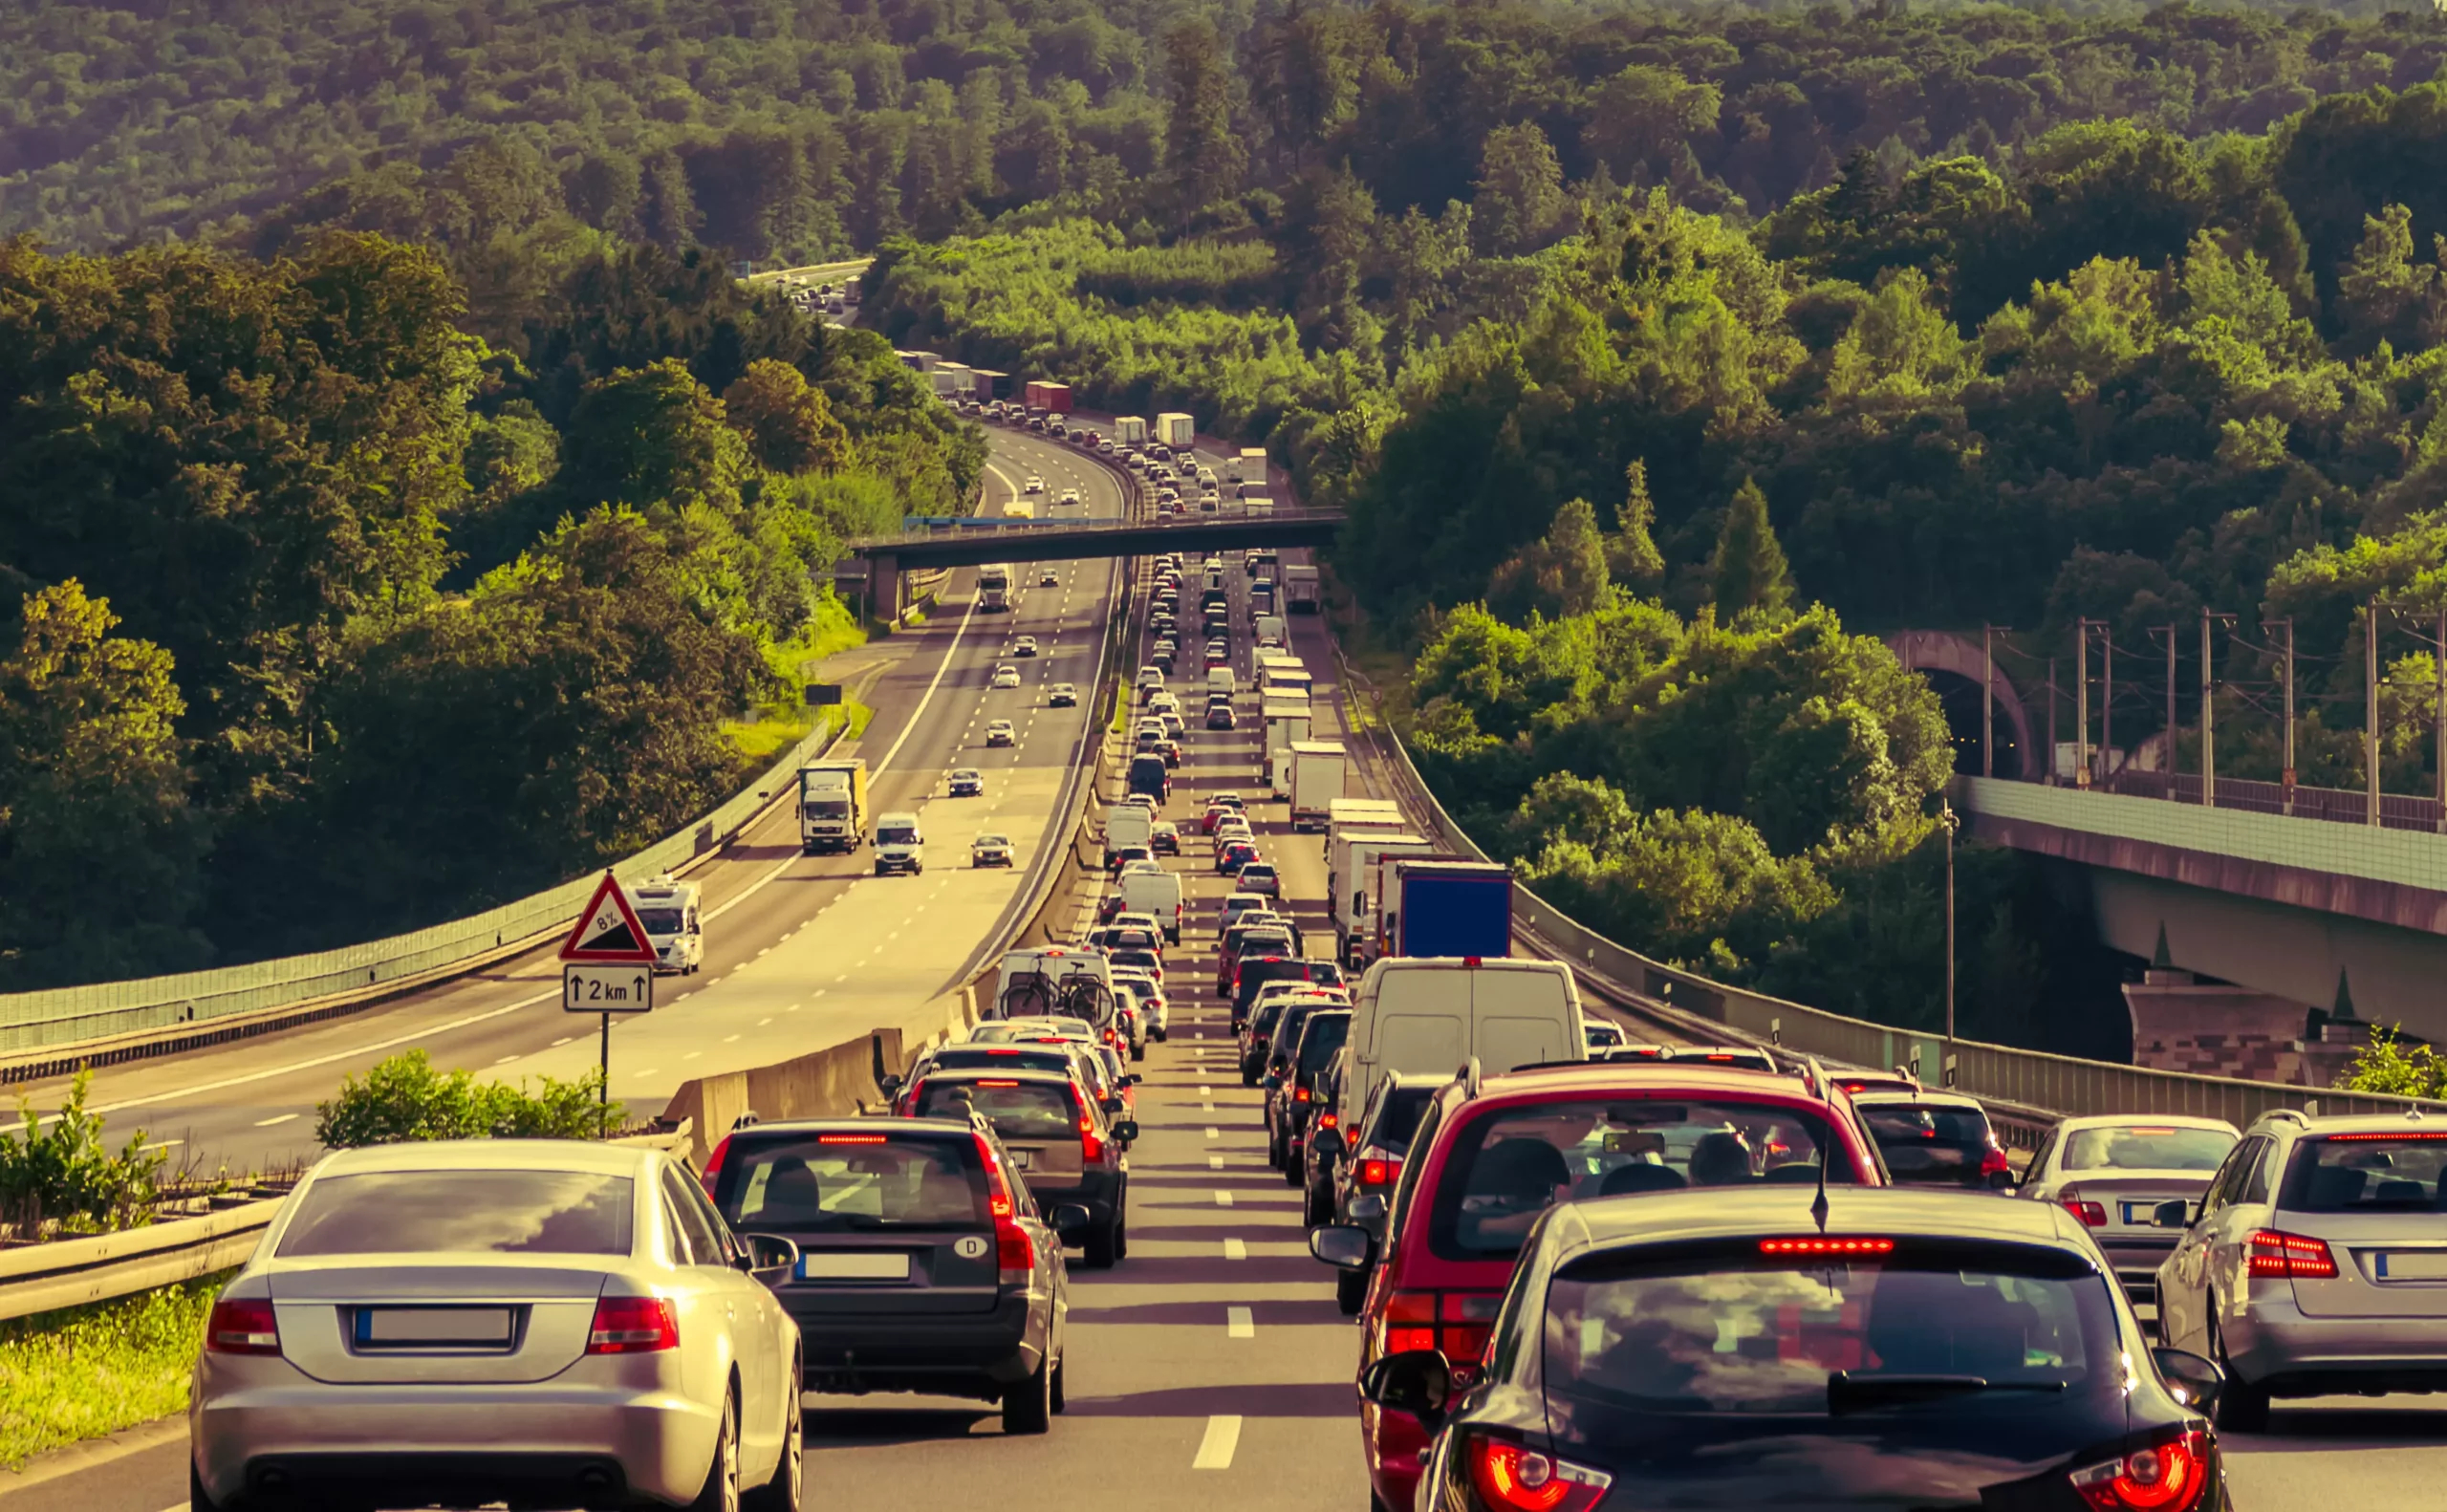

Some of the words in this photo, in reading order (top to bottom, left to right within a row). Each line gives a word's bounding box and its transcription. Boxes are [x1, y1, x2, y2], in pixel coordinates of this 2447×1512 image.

[596, 911, 617, 930] 8%
[589, 980, 601, 1001] 2
[605, 983, 627, 1001] km
[966, 1241, 977, 1254] D
